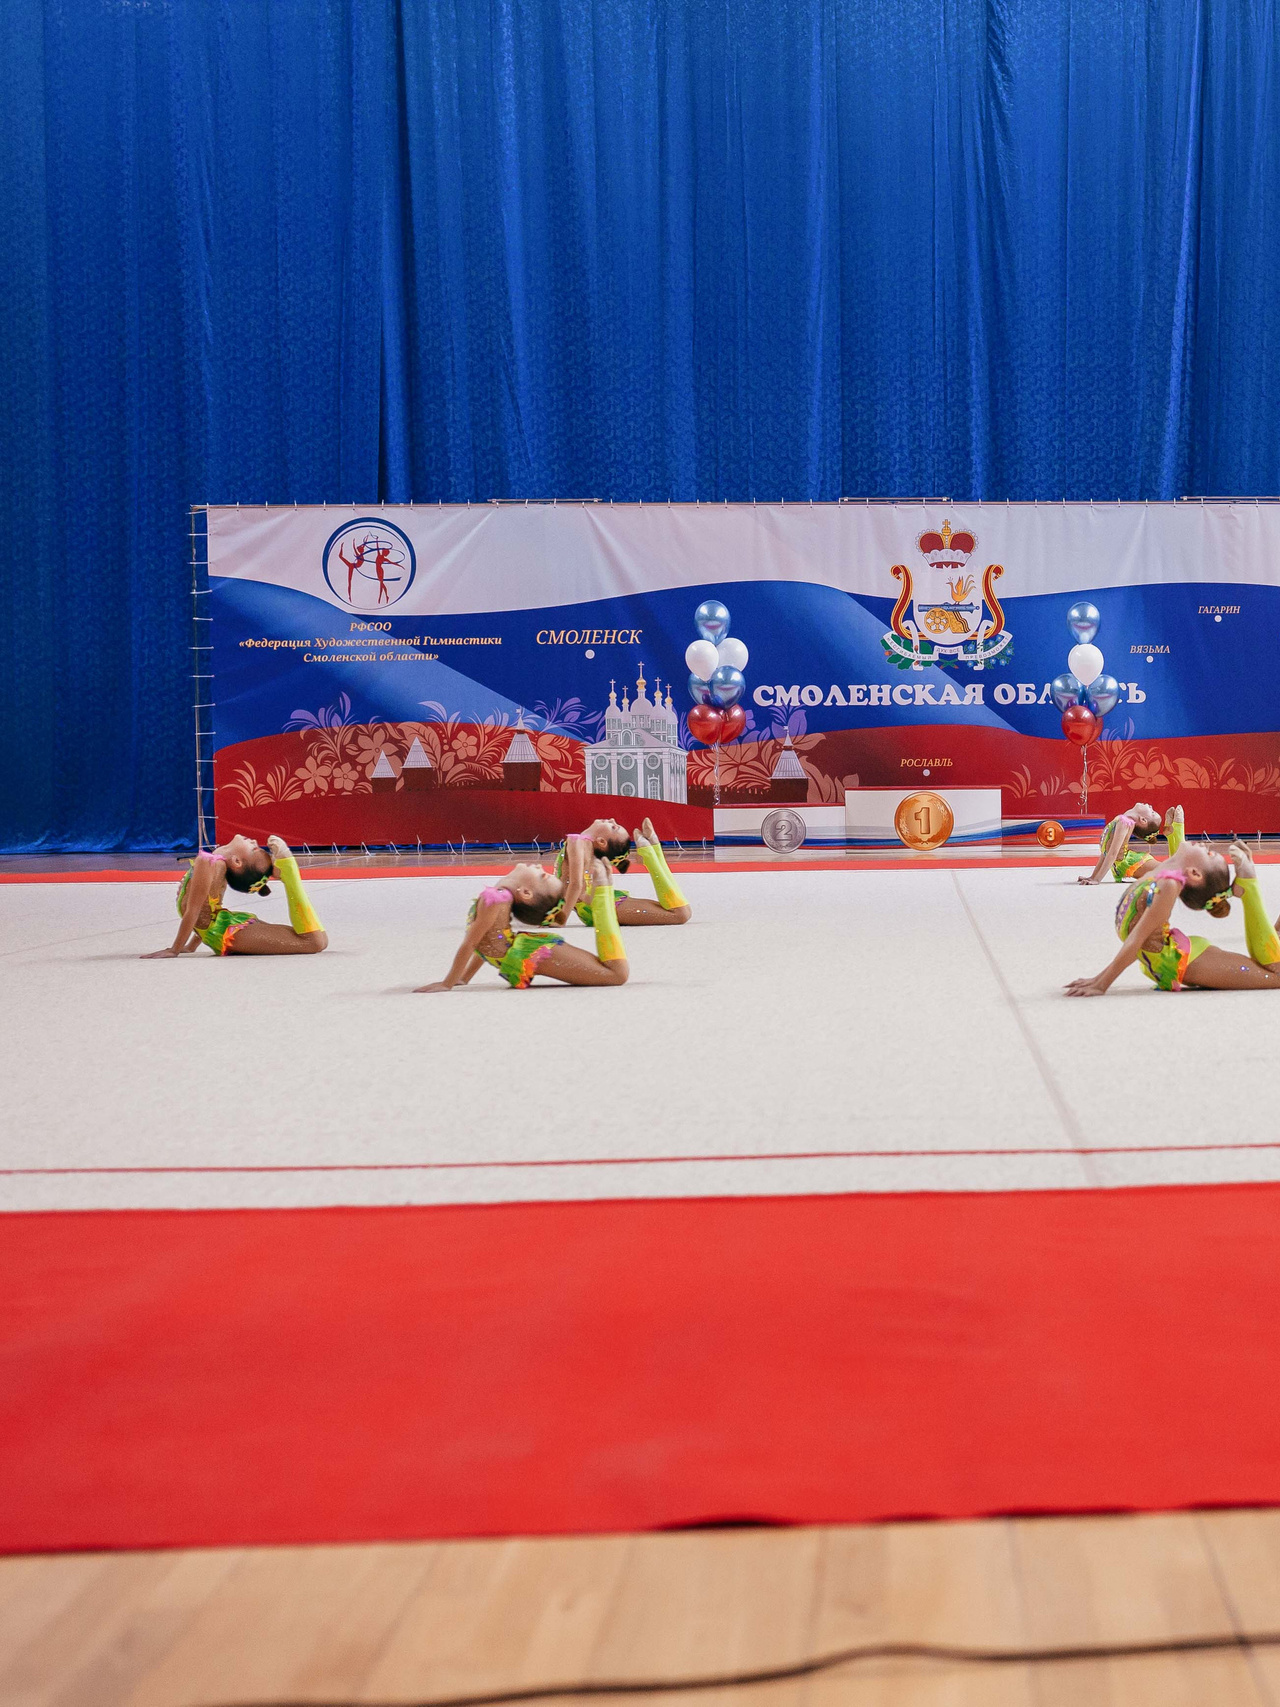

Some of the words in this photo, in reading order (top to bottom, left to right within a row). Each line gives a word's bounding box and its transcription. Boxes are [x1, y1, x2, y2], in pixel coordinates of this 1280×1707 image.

[1198, 606, 1241, 614] ГАГАРИН
[349, 621, 392, 632] РФСОО
[239, 637, 311, 650] «Федерация
[314, 635, 420, 648] Художественной
[422, 635, 502, 645] Гимнастики
[536, 629, 643, 645] СМОЛЕНСК
[1129, 645, 1171, 654] ВЯЗЬМА
[303, 651, 376, 663] Смоленской
[379, 651, 439, 662] области»
[752, 683, 985, 707] СМОЛЕНСКАЯ
[900, 758, 953, 767] РОСЛАВЛЬ
[914, 806, 931, 834] 1
[774, 819, 793, 841] 2
[1045, 827, 1056, 841] 3
